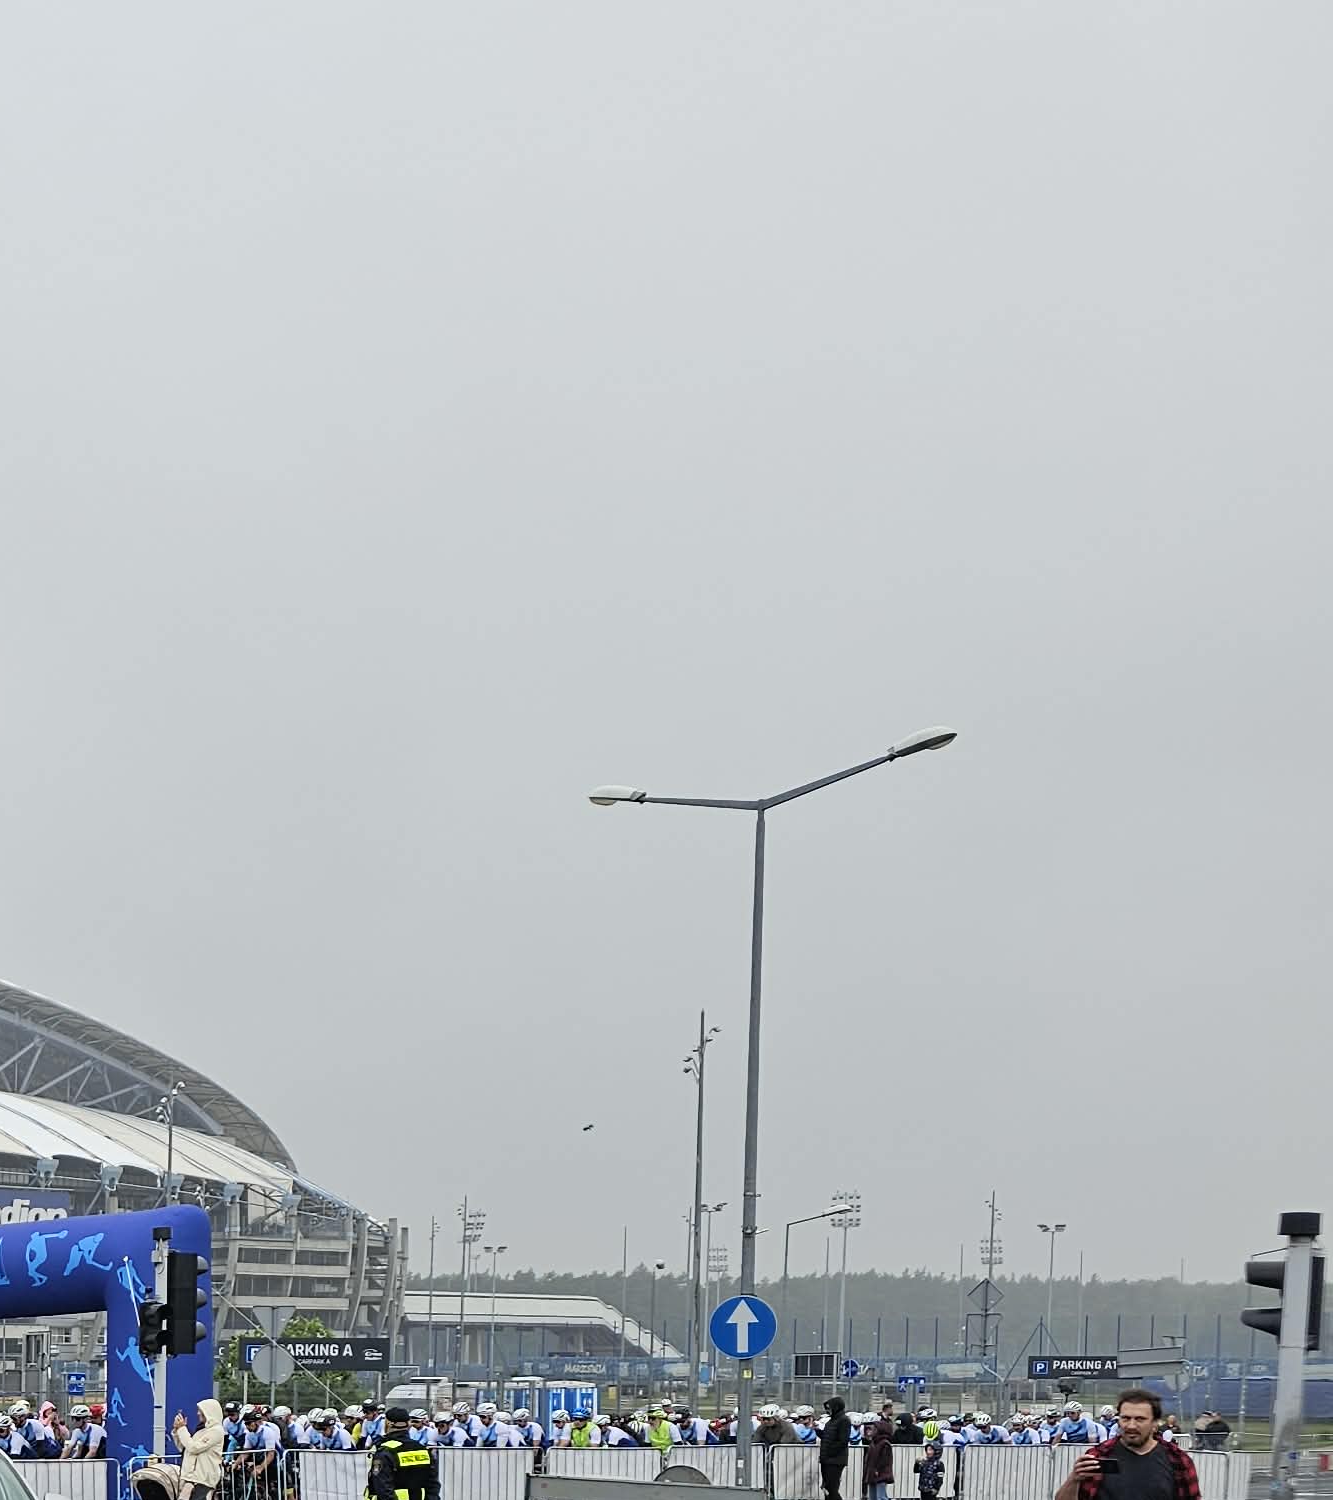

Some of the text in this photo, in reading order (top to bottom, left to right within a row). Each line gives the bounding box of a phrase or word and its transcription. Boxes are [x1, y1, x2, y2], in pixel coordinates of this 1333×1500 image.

[279, 1343, 339, 1357] ARKING
[342, 1343, 353, 1357] A
[1036, 1363, 1045, 1373] P
[1052, 1360, 1102, 1370] PARKING
